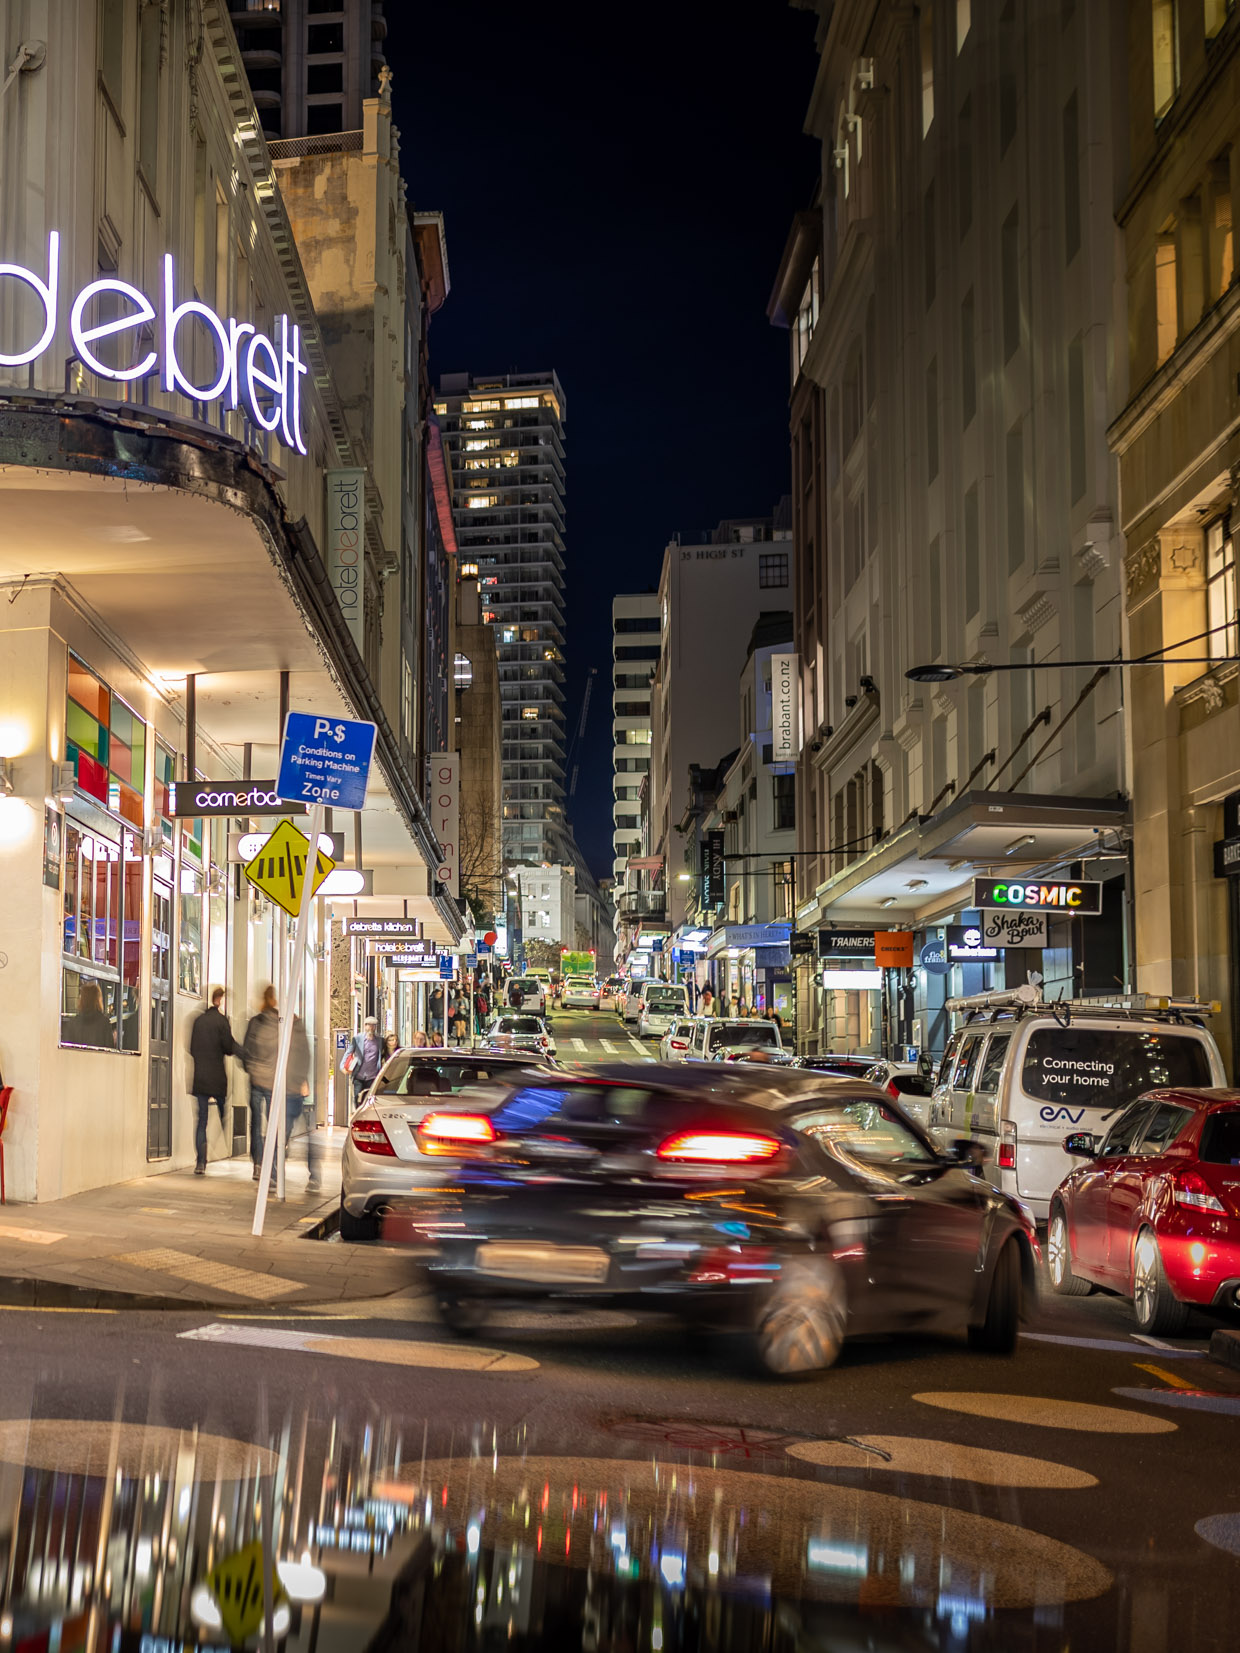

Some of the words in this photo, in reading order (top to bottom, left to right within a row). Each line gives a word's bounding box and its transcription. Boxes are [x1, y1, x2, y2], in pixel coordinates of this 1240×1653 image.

[731, 548, 745, 558] ST
[779, 660, 791, 749] brabant.co.nz
[298, 745, 343, 760] Conditions
[344, 753, 356, 761] on
[290, 755, 323, 769] Parking
[324, 760, 360, 773] Machine
[305, 771, 325, 781] Times
[326, 775, 342, 784] Vary
[195, 787, 282, 808] cornerba
[302, 782, 340, 800] Zone
[992, 884, 1082, 907] COSMIC
[384, 922, 413, 932] kitchen
[985, 911, 1040, 938] Shaka
[1007, 921, 1045, 945] Bowl
[830, 937, 876, 947] TRAINERS
[1042, 1057, 1114, 1075] Connecting
[1042, 1074, 1071, 1085] your
[1073, 1074, 1110, 1087] home
